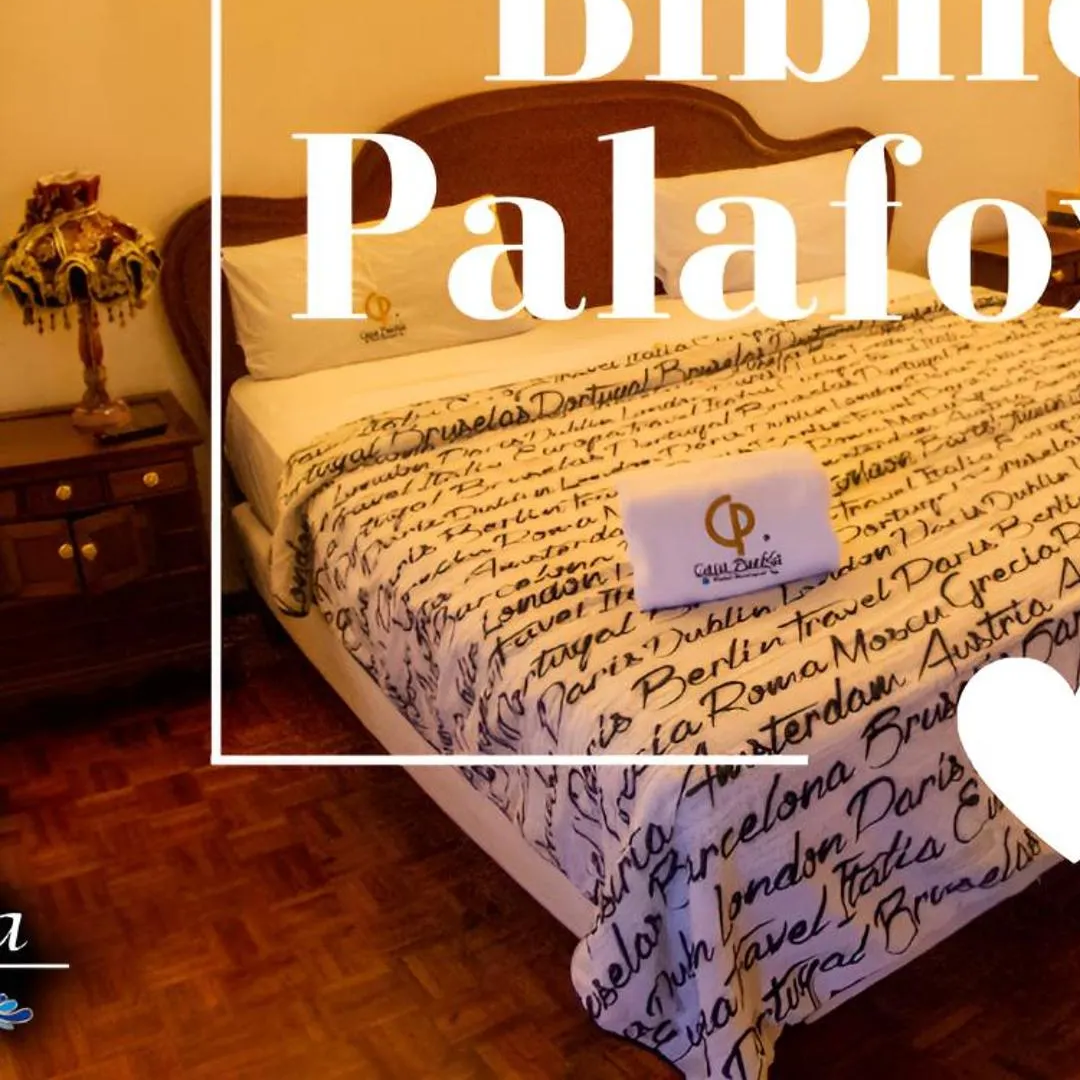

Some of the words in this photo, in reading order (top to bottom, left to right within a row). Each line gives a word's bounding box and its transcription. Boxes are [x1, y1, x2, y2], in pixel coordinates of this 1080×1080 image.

[642, 604, 773, 658] Dublin
[918, 598, 1054, 680] Austria
[631, 633, 786, 710] Berlin
[699, 658, 830, 726] Roma
